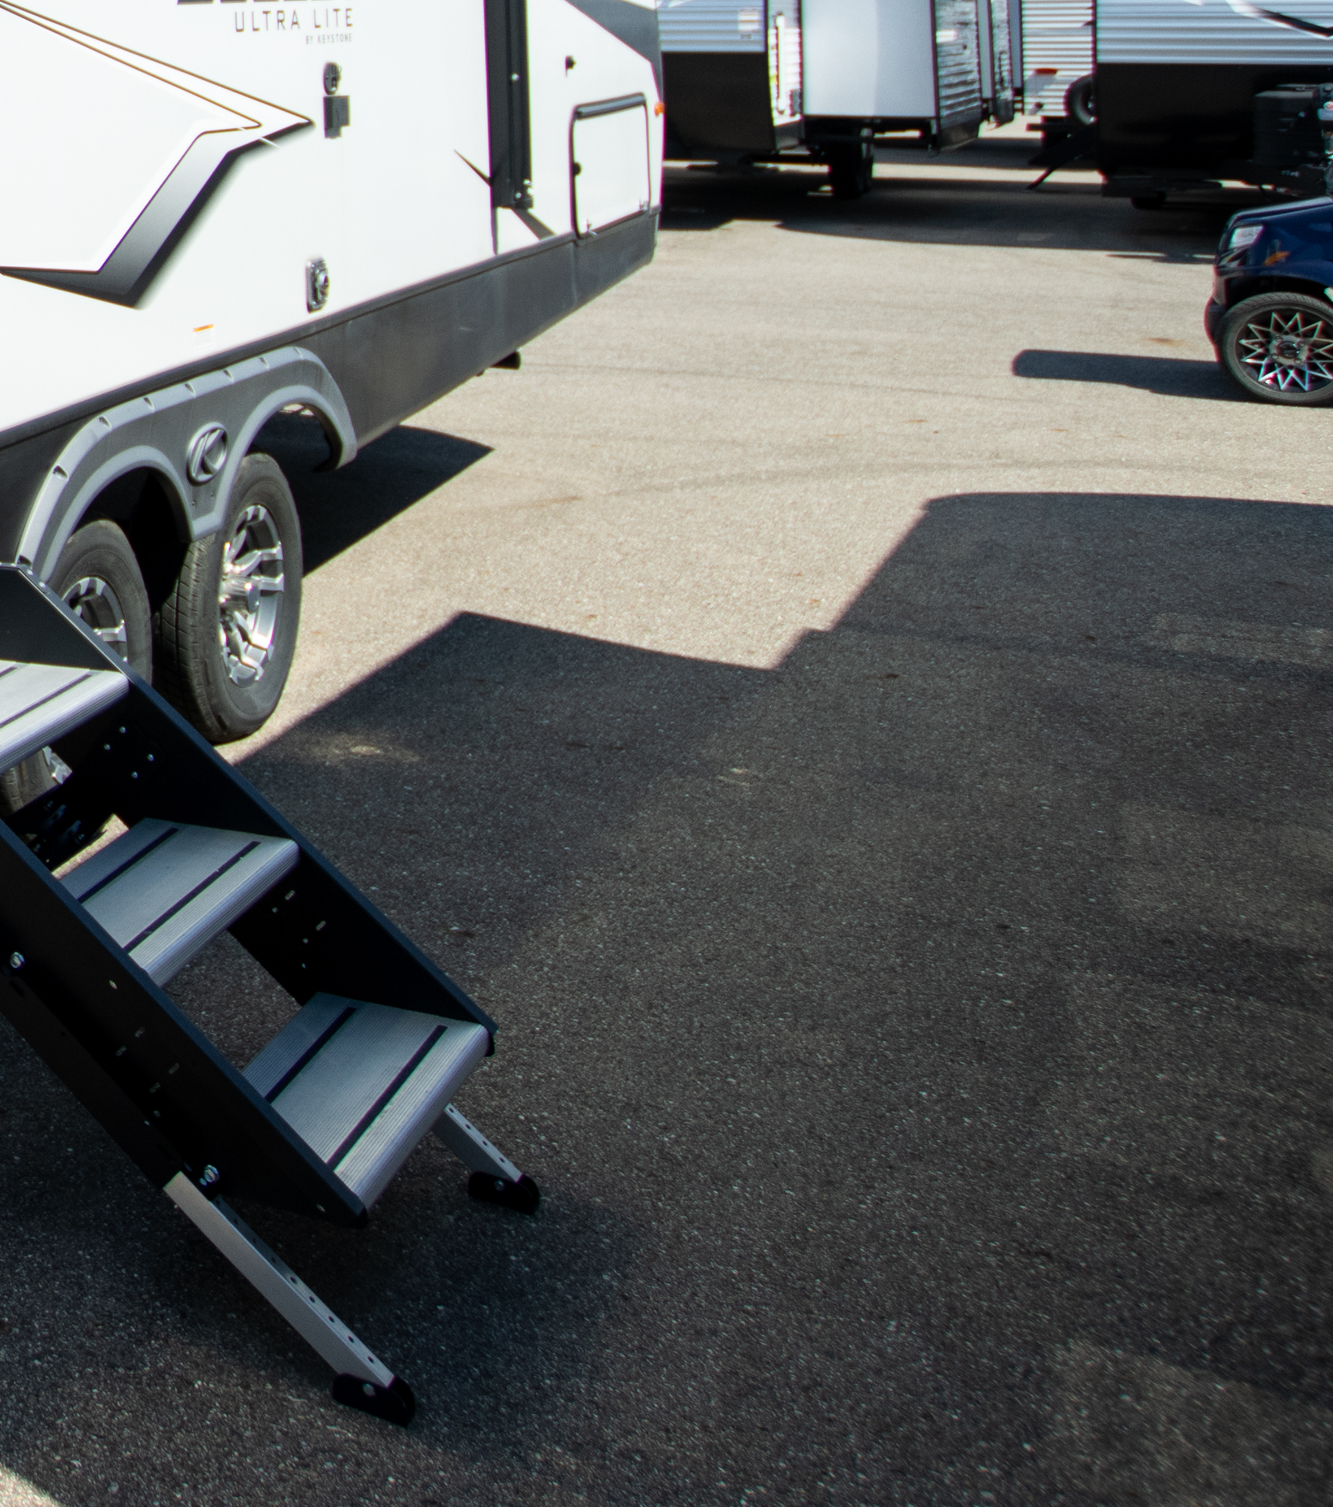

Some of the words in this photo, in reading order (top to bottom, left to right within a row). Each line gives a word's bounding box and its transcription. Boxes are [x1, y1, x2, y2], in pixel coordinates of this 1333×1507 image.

[234, 9, 300, 32] ULTRA
[313, 7, 353, 29] LITE
[306, 35, 313, 45] BY
[317, 33, 352, 44] KEYSTONE
